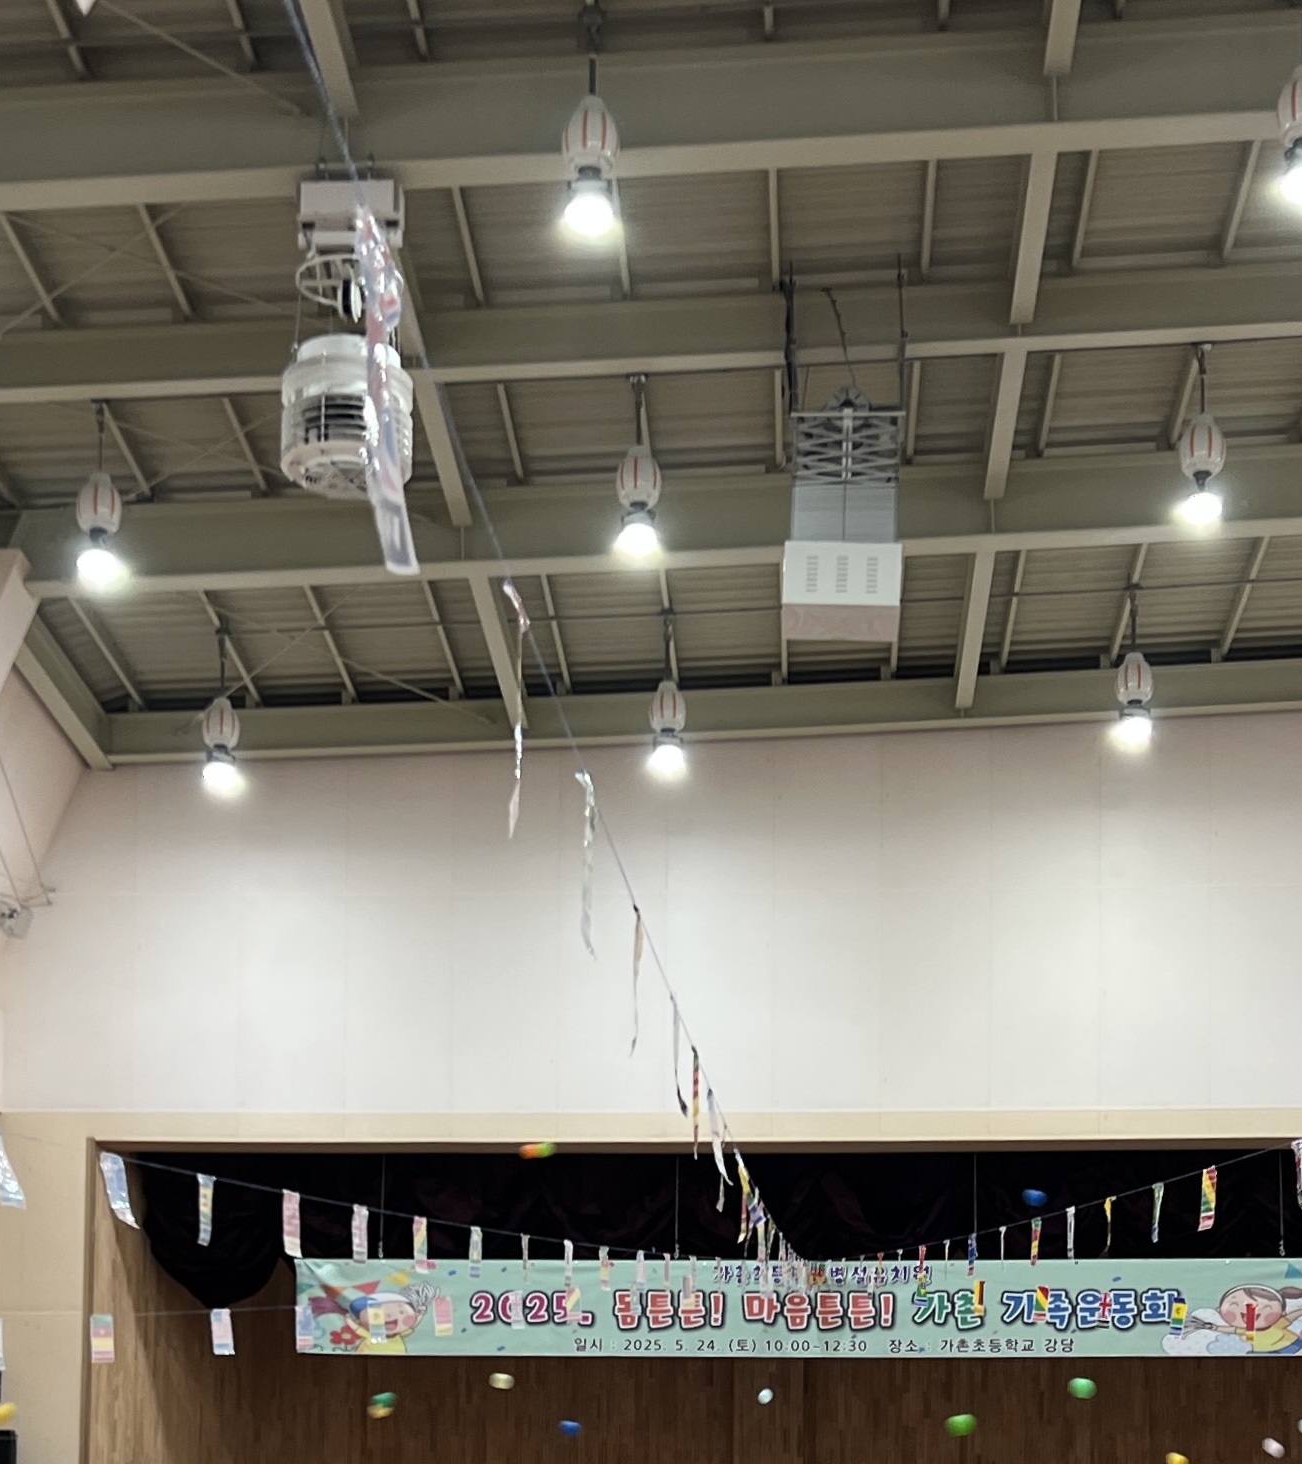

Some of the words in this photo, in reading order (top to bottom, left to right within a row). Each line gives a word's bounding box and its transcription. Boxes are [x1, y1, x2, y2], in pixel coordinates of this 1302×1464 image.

[470, 1290, 593, 1324] 2025.
[614, 1290, 726, 1329] 몸튼튼!
[743, 1291, 894, 1330] 마음튼튼!
[913, 1290, 984, 1330] 가촌
[1003, 1289, 1179, 1330] 가족운동회
[574, 1338, 603, 1352] 일시
[624, 1339, 667, 1352] 2025.
[675, 1339, 688, 1352] 5.
[697, 1339, 721, 1352] 24.
[728, 1338, 757, 1353] (토)
[765, 1339, 867, 1353] 10:00~12:30
[889, 1338, 919, 1353] 장소
[940, 1338, 1035, 1353] 가촌초등학교
[1044, 1338, 1075, 1353] 강당
